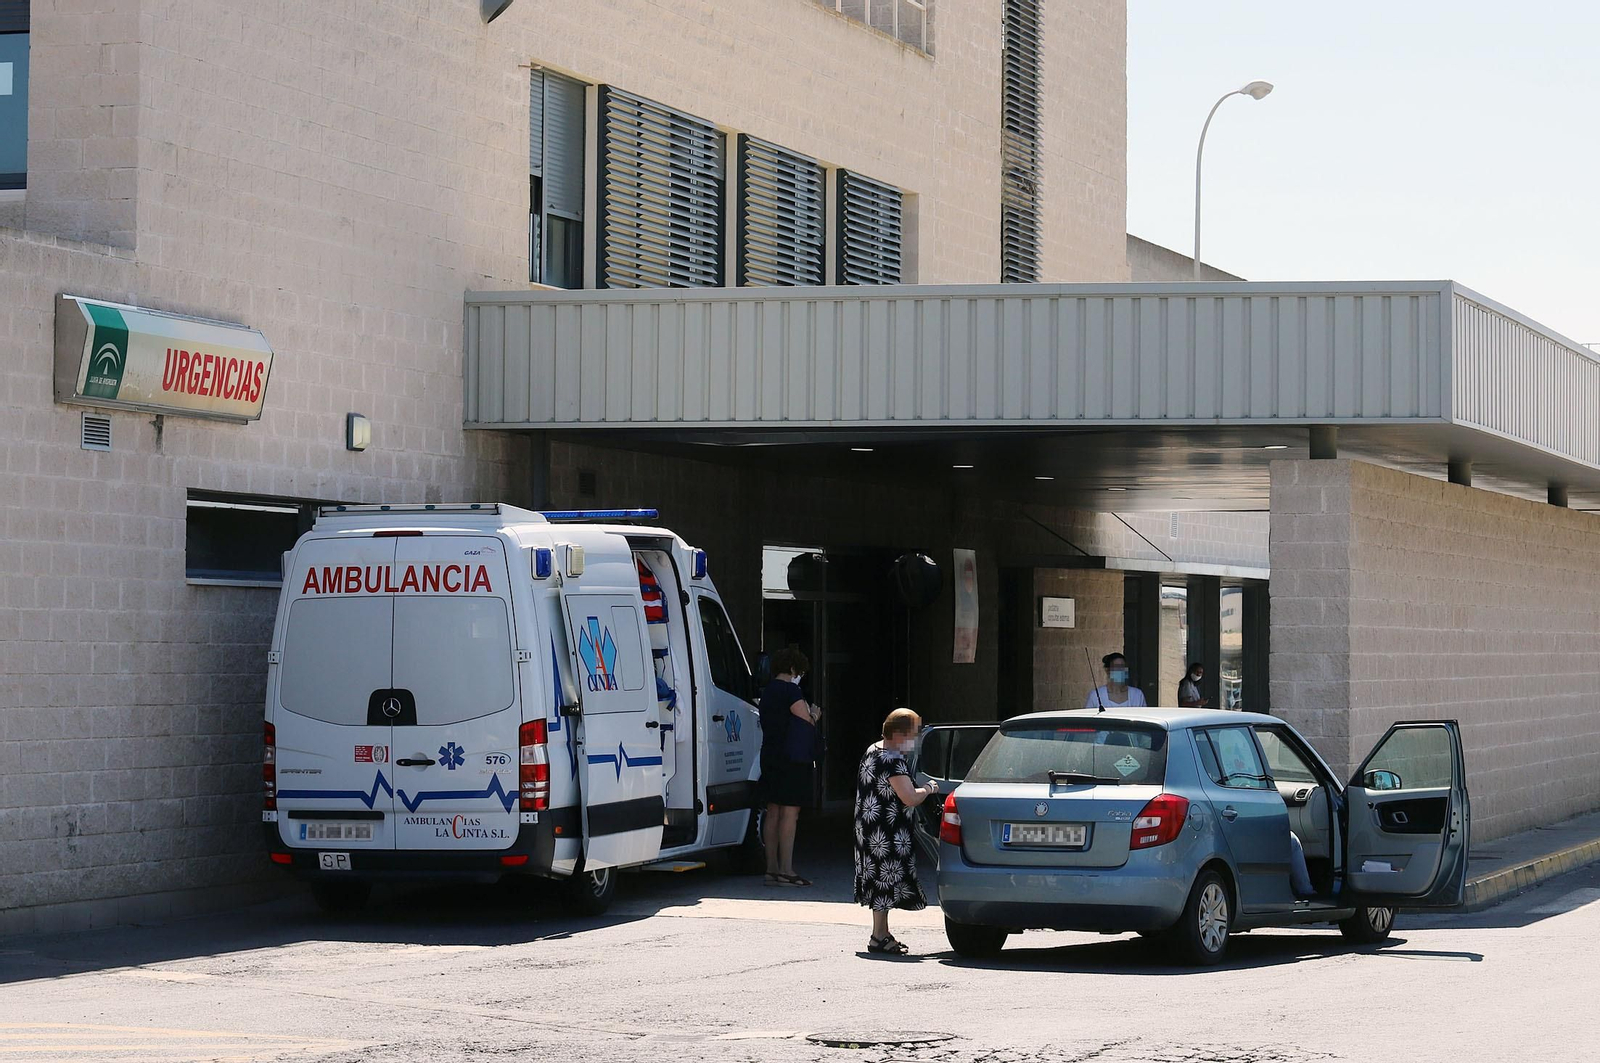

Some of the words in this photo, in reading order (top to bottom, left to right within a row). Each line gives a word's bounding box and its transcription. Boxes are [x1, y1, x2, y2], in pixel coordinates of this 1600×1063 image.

[162, 348, 264, 403] URGENCIAS
[302, 564, 493, 594] AMBULANCIA
[485, 755, 506, 765] 576
[435, 828, 450, 838] LA
[452, 815, 488, 839] CINTA
[490, 829, 510, 839] S.L.
[322, 854, 347, 868] SP
